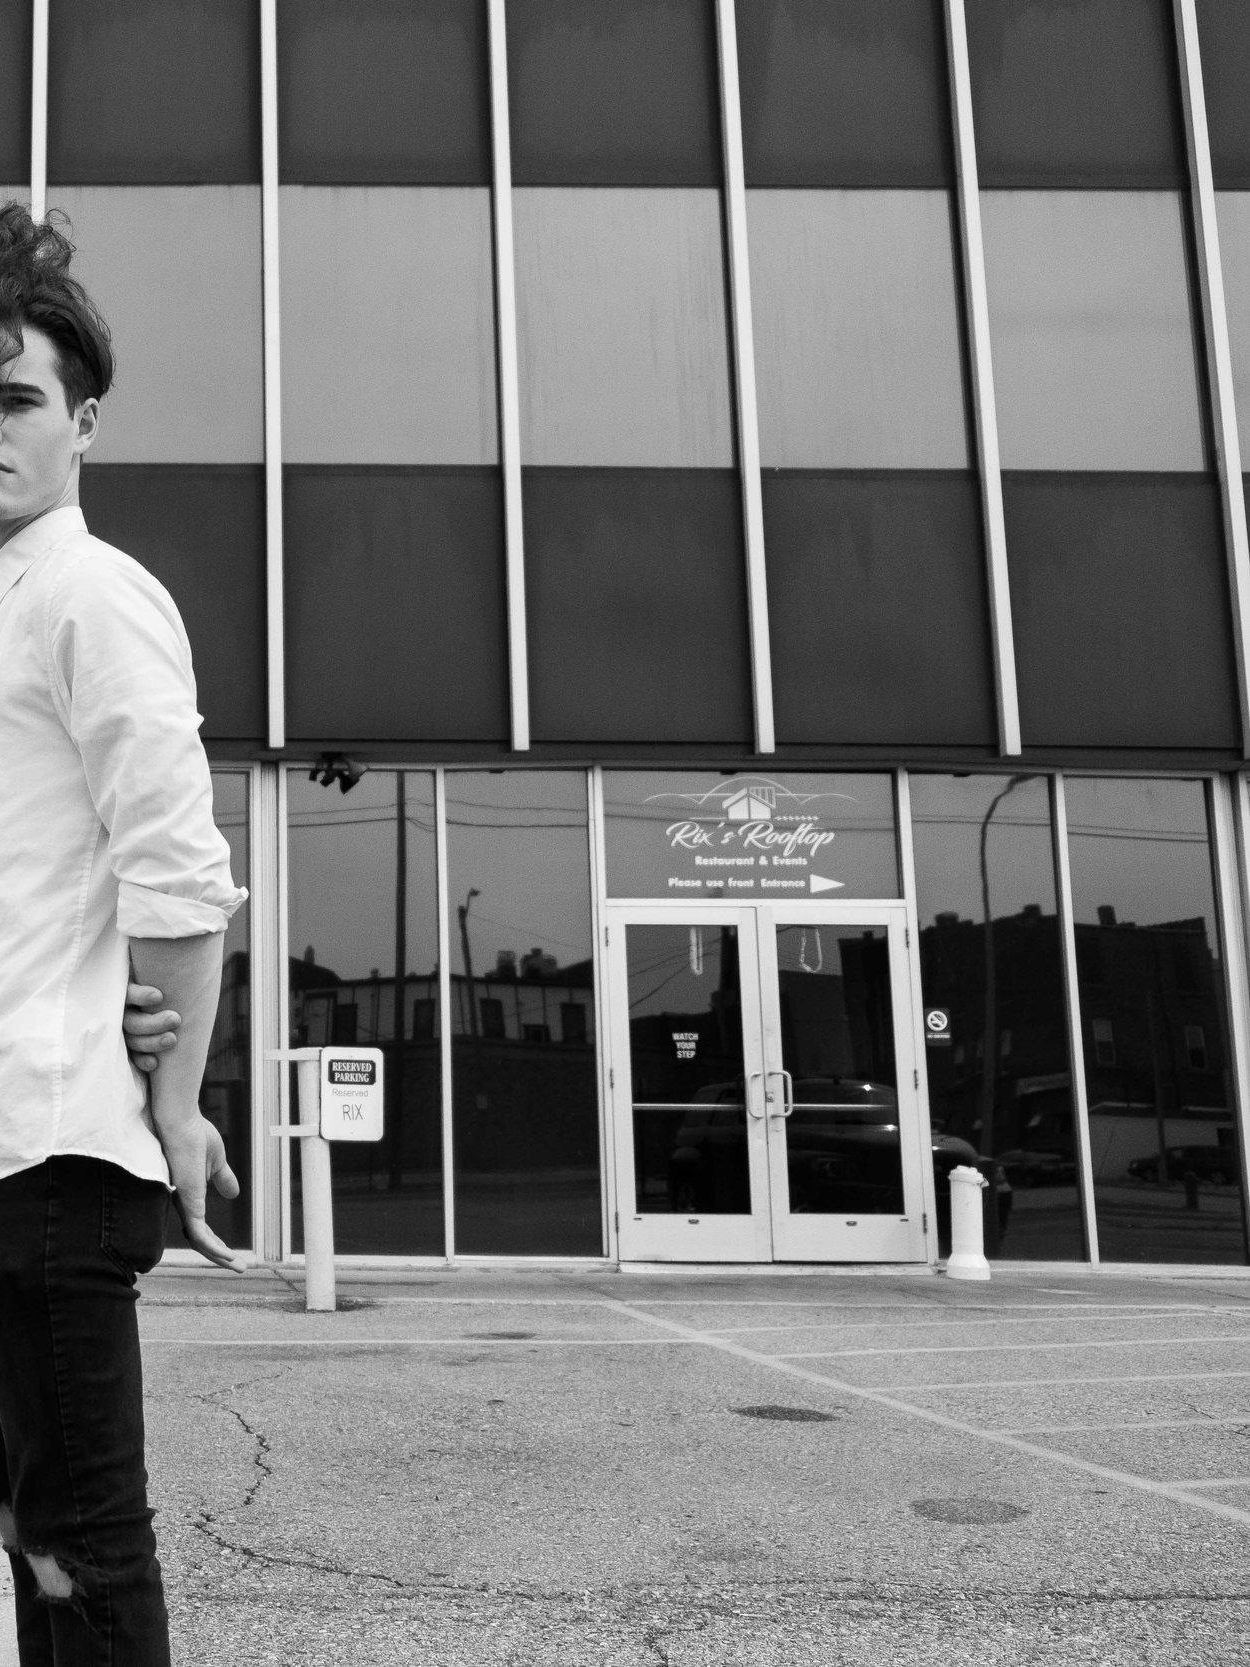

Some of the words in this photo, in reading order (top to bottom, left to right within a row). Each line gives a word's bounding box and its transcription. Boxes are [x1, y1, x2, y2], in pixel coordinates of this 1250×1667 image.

[665, 820, 737, 849] Rix's
[737, 820, 835, 857] Rooftop
[695, 856, 754, 866] Restaurant
[759, 856, 768, 866] &
[772, 856, 808, 866] Events
[668, 877, 702, 888] Please
[706, 879, 724, 888] use
[728, 877, 754, 888] front
[760, 878, 806, 888] Entrance
[676, 1050, 696, 1059] STEP
[331, 1061, 372, 1072] RESERVED
[334, 1072, 370, 1083] PARKING
[331, 1087, 369, 1098] Reserved
[342, 1103, 364, 1121] RIX
